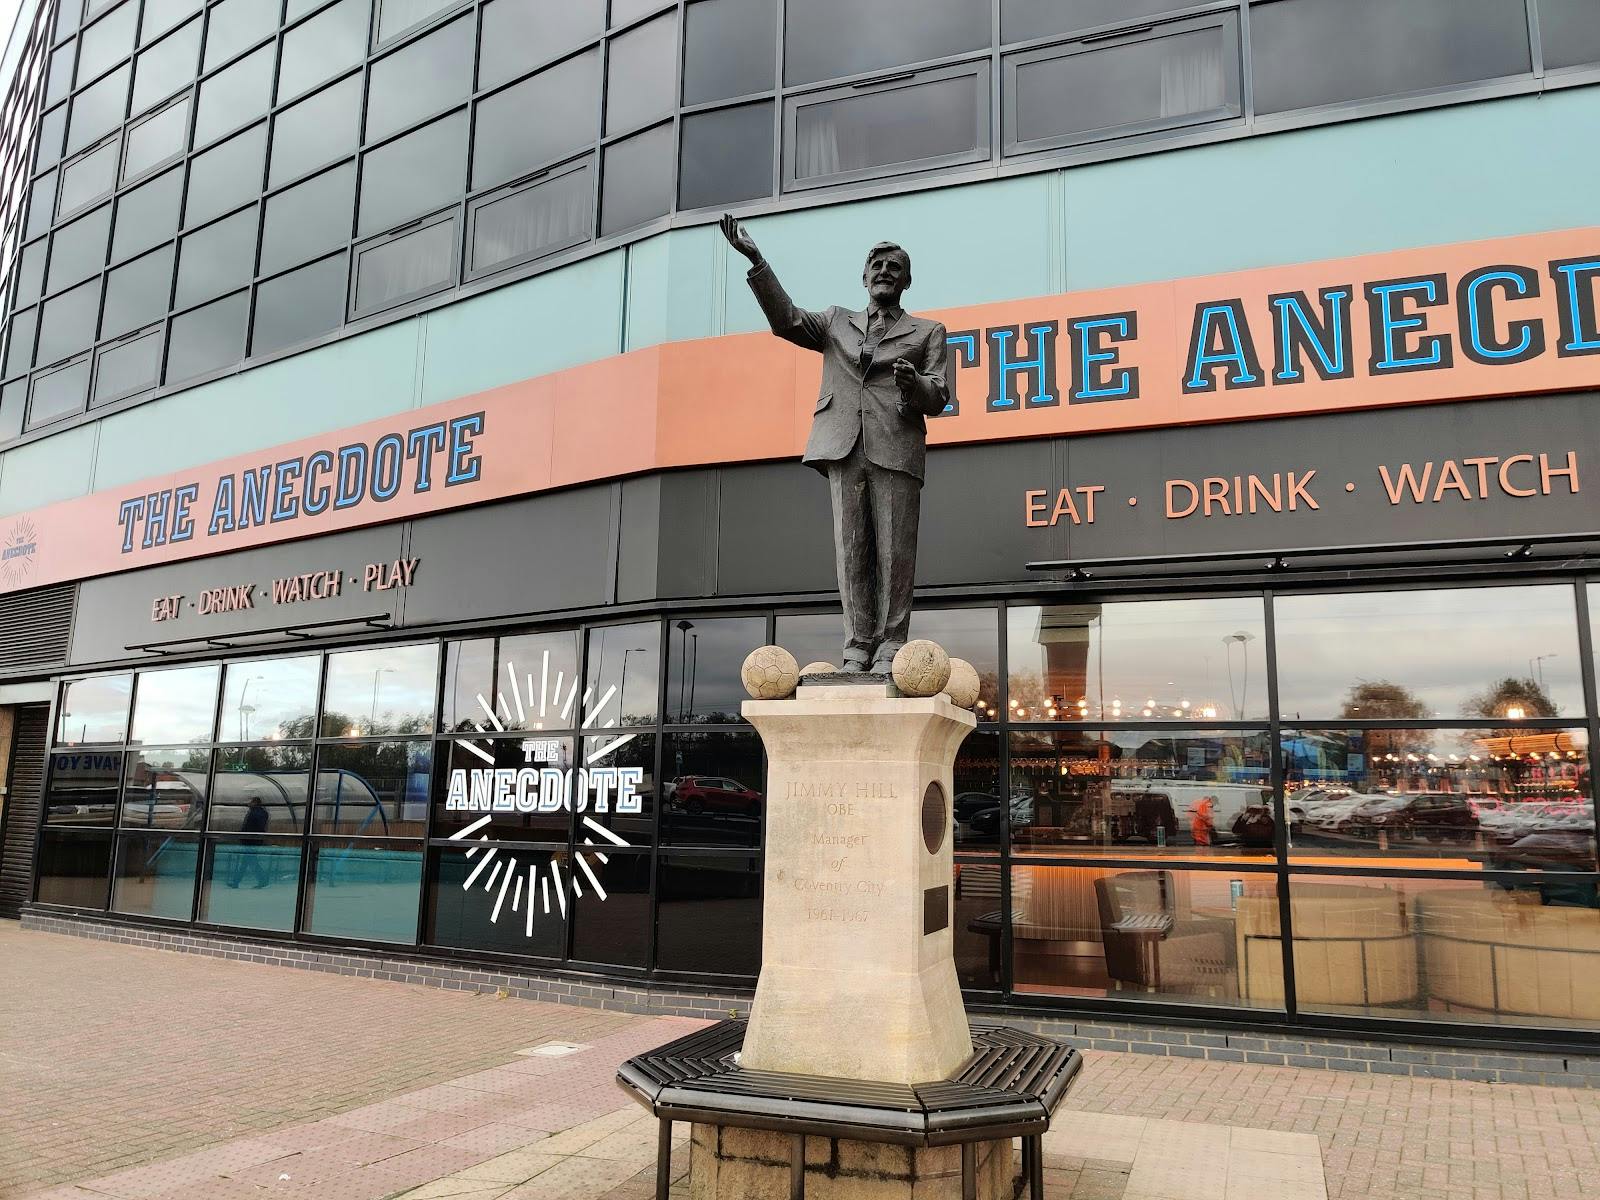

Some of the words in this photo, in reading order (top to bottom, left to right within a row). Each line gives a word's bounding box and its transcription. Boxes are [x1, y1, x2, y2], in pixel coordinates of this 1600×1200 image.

[1181, 255, 1600, 395] ANECD
[118, 482, 199, 554] THE
[207, 410, 486, 536] ANECDOTE
[1025, 485, 1105, 528] EAT
[1164, 469, 1320, 519] DRINK
[1378, 450, 1580, 505] WATCH
[151, 595, 184, 622] EAT
[198, 583, 255, 615] DRINK
[272, 569, 342, 604] WATCH
[363, 557, 419, 592] PLAY
[521, 740, 559, 762] THE
[445, 766, 644, 813] ANECDOTE
[785, 782, 848, 800] JIMMY
[855, 782, 898, 799] HILL
[827, 803, 856, 816] OBE
[813, 834, 869, 848] Manager
[831, 856, 848, 872] of
